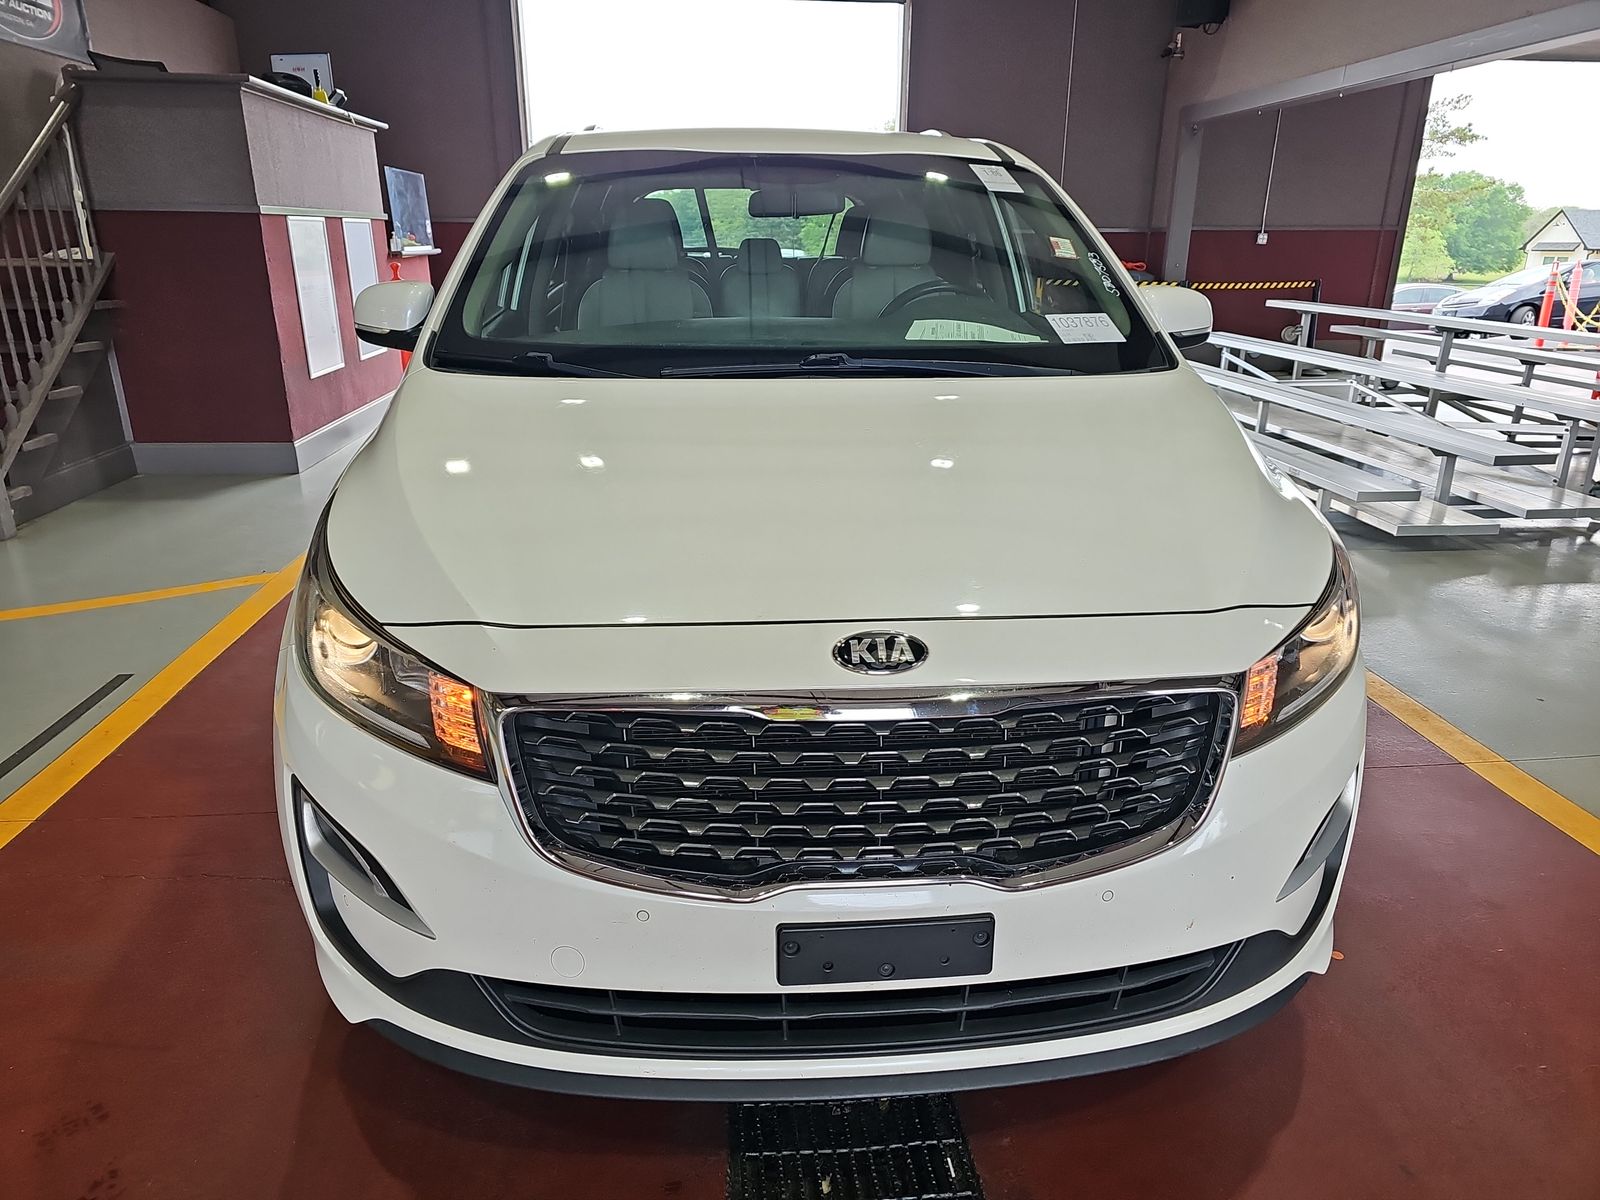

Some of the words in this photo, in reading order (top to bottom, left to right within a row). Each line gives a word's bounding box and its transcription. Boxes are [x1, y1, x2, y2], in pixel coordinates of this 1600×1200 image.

[9, 0, 52, 21] AUCTION
[1051, 316, 1110, 329] 1037876
[849, 638, 915, 664] KIA
